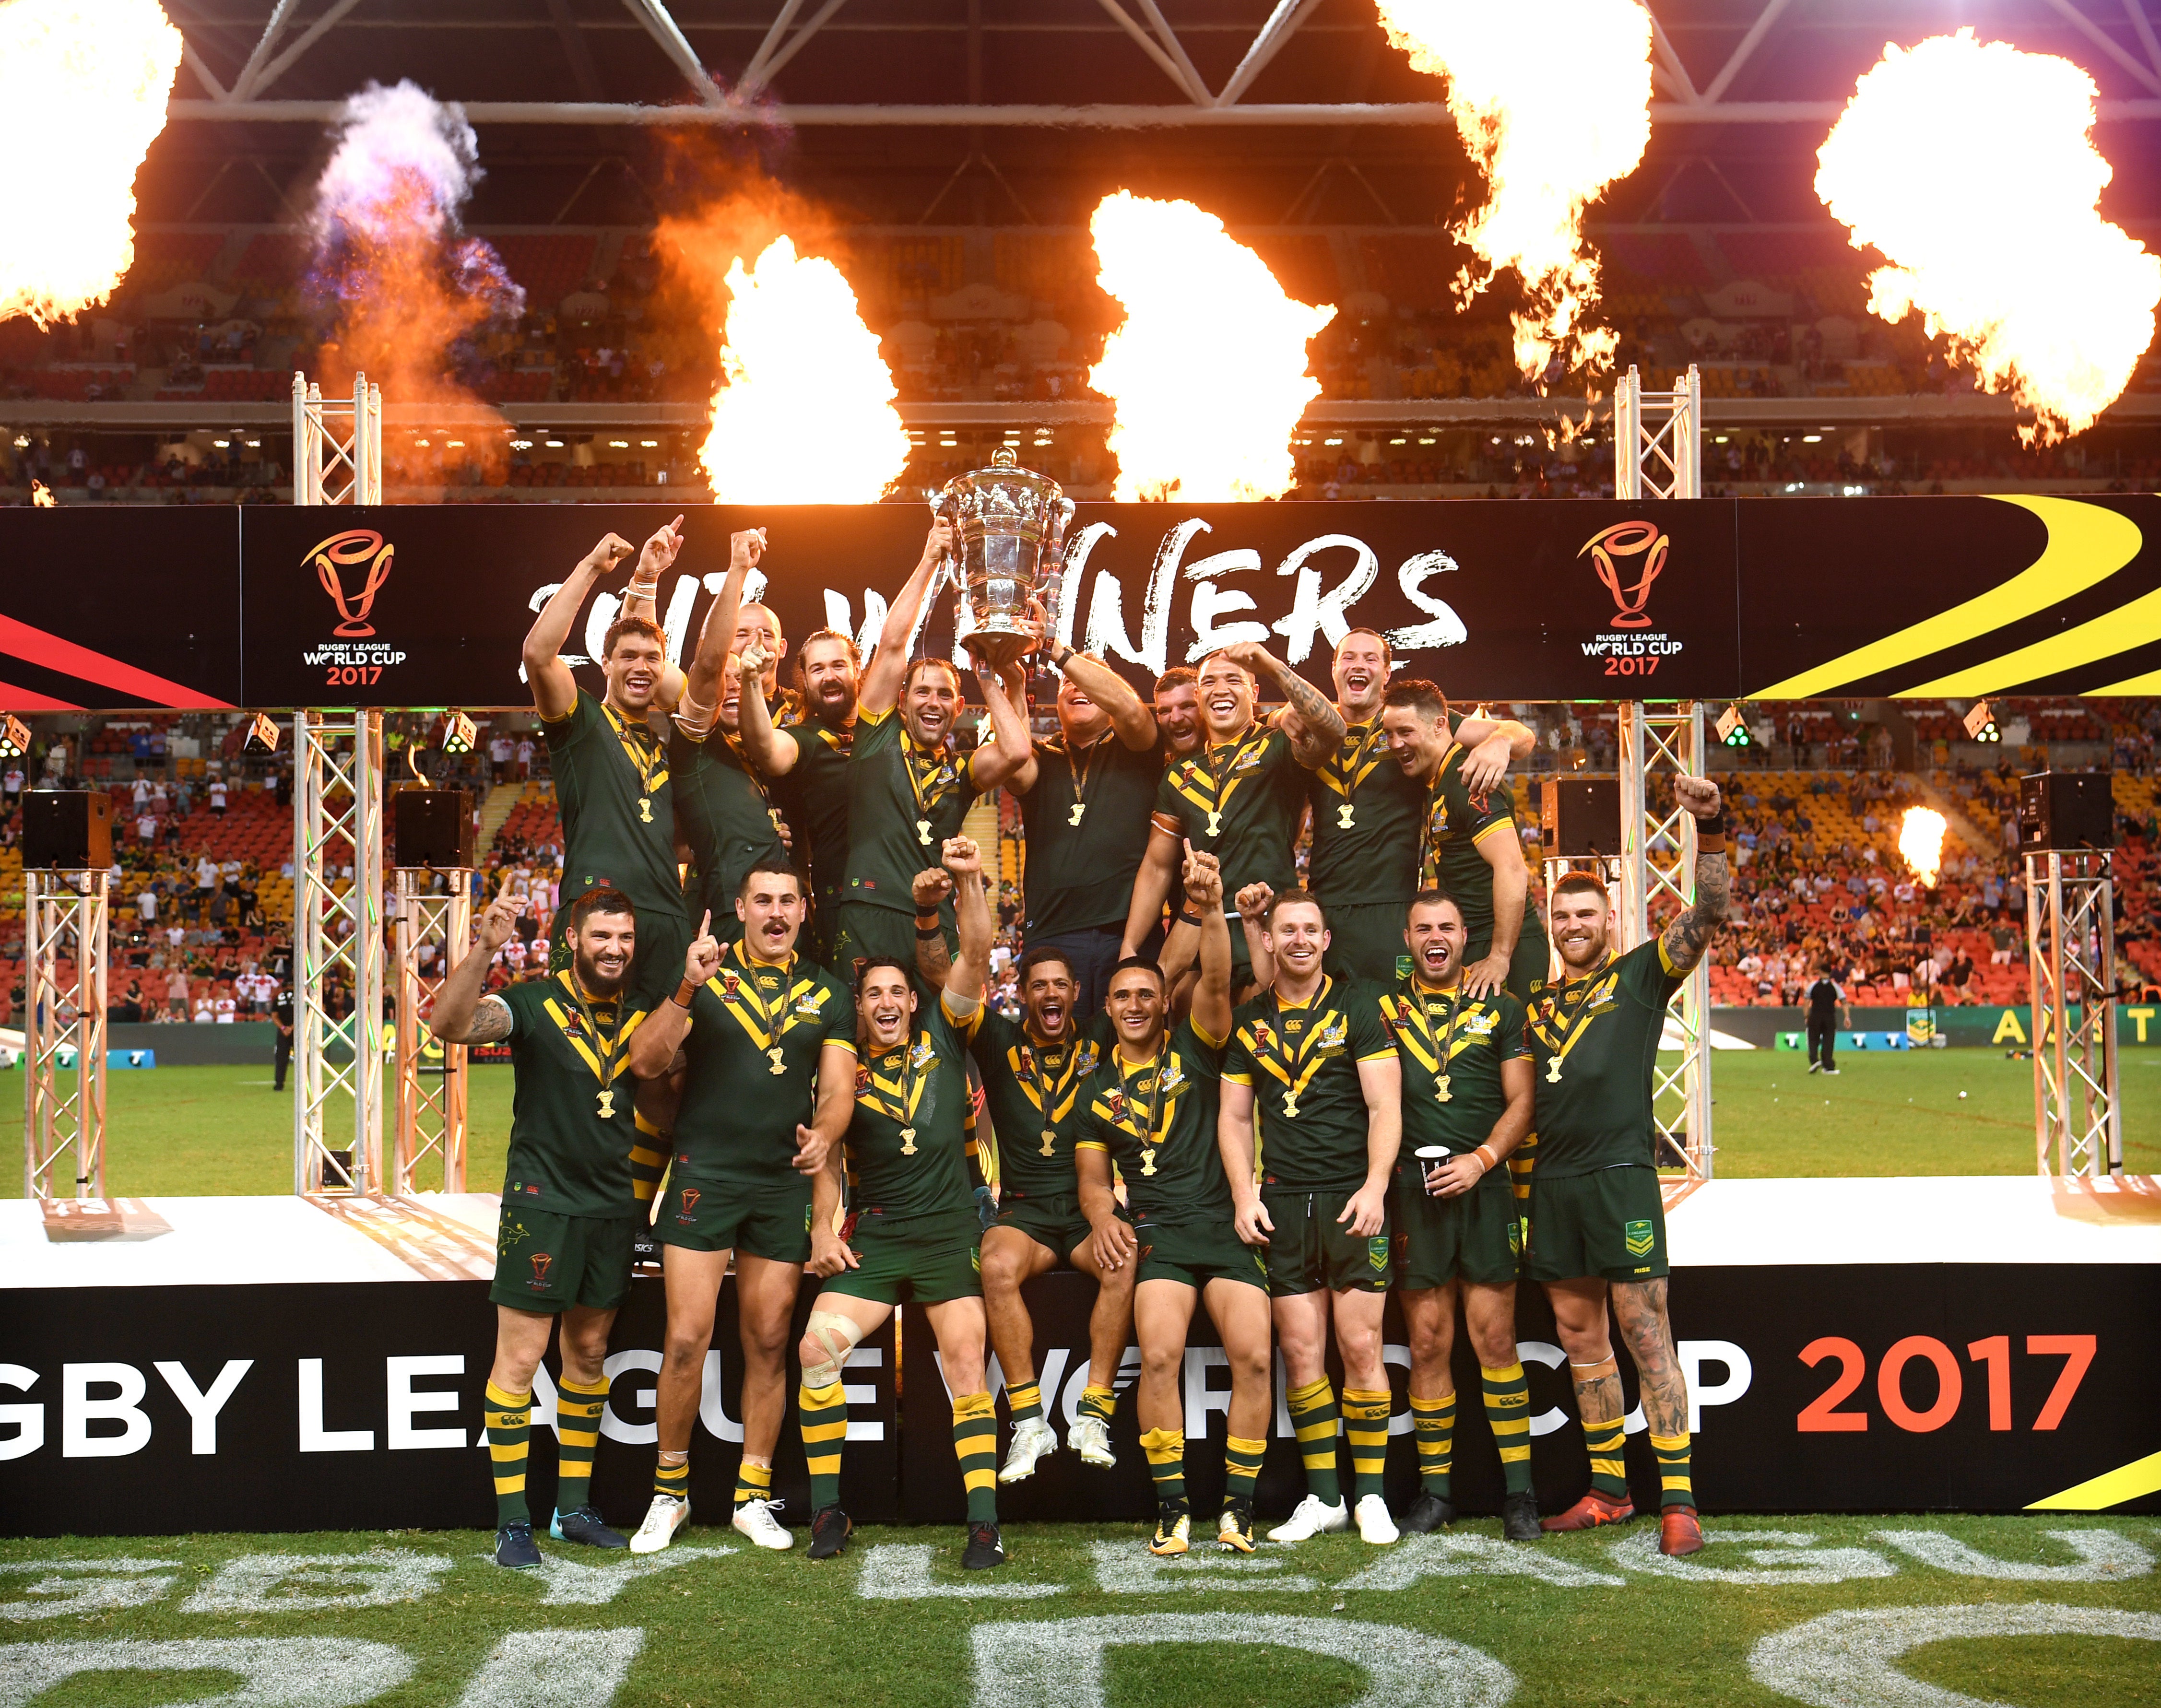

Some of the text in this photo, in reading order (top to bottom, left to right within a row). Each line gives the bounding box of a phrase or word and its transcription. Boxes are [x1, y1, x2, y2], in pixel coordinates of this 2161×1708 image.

[824, 518, 1467, 681] WNERS
[1582, 642, 1683, 656] WORLD CUP
[304, 652, 407, 666] WORLD CUP
[1605, 657, 1660, 676] 2017
[327, 667, 383, 685] 2017
[933, 1345, 1414, 1444] WOR
[1797, 1334, 2097, 1433] 2017
